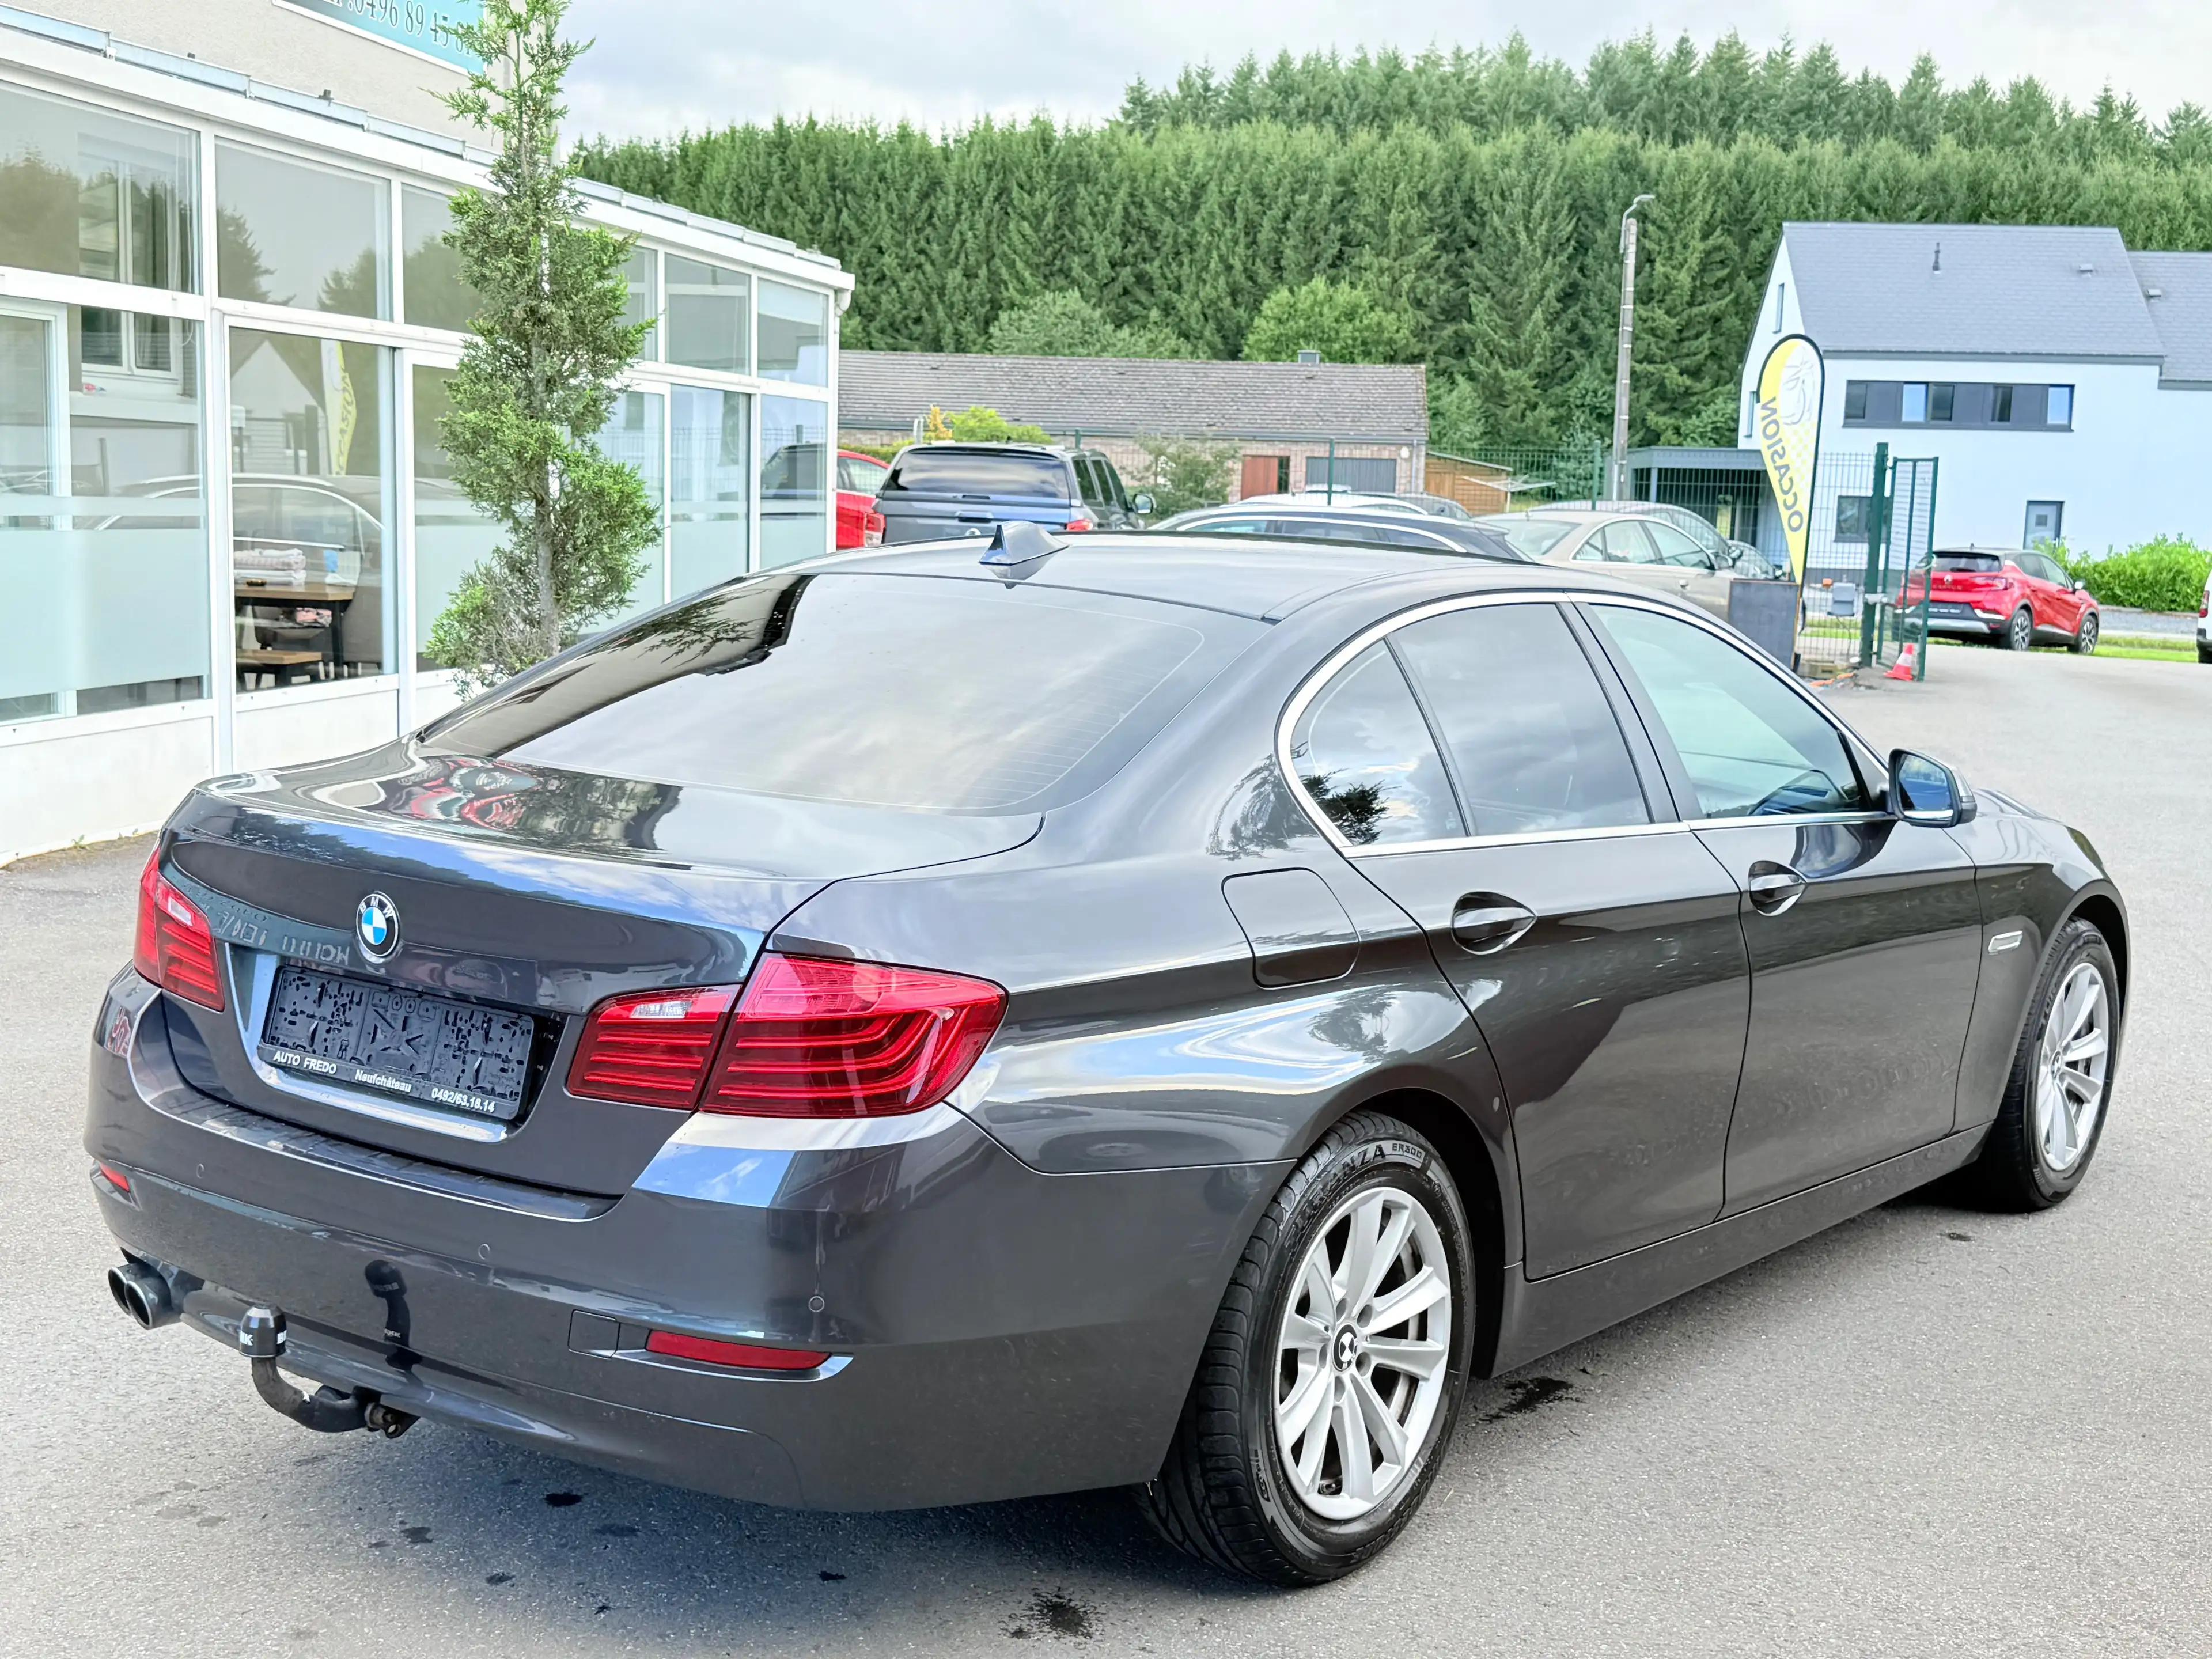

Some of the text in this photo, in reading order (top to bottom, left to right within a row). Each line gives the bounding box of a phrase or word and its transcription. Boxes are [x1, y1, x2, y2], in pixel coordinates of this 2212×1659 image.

[406, 1, 424, 36] 89
[359, 896, 394, 919] BMW
[273, 1050, 301, 1066] AUTO
[303, 1056, 337, 1075] FREDO
[354, 1069, 412, 1093] Neufchâteau
[1392, 1142, 1423, 1159] ER300
